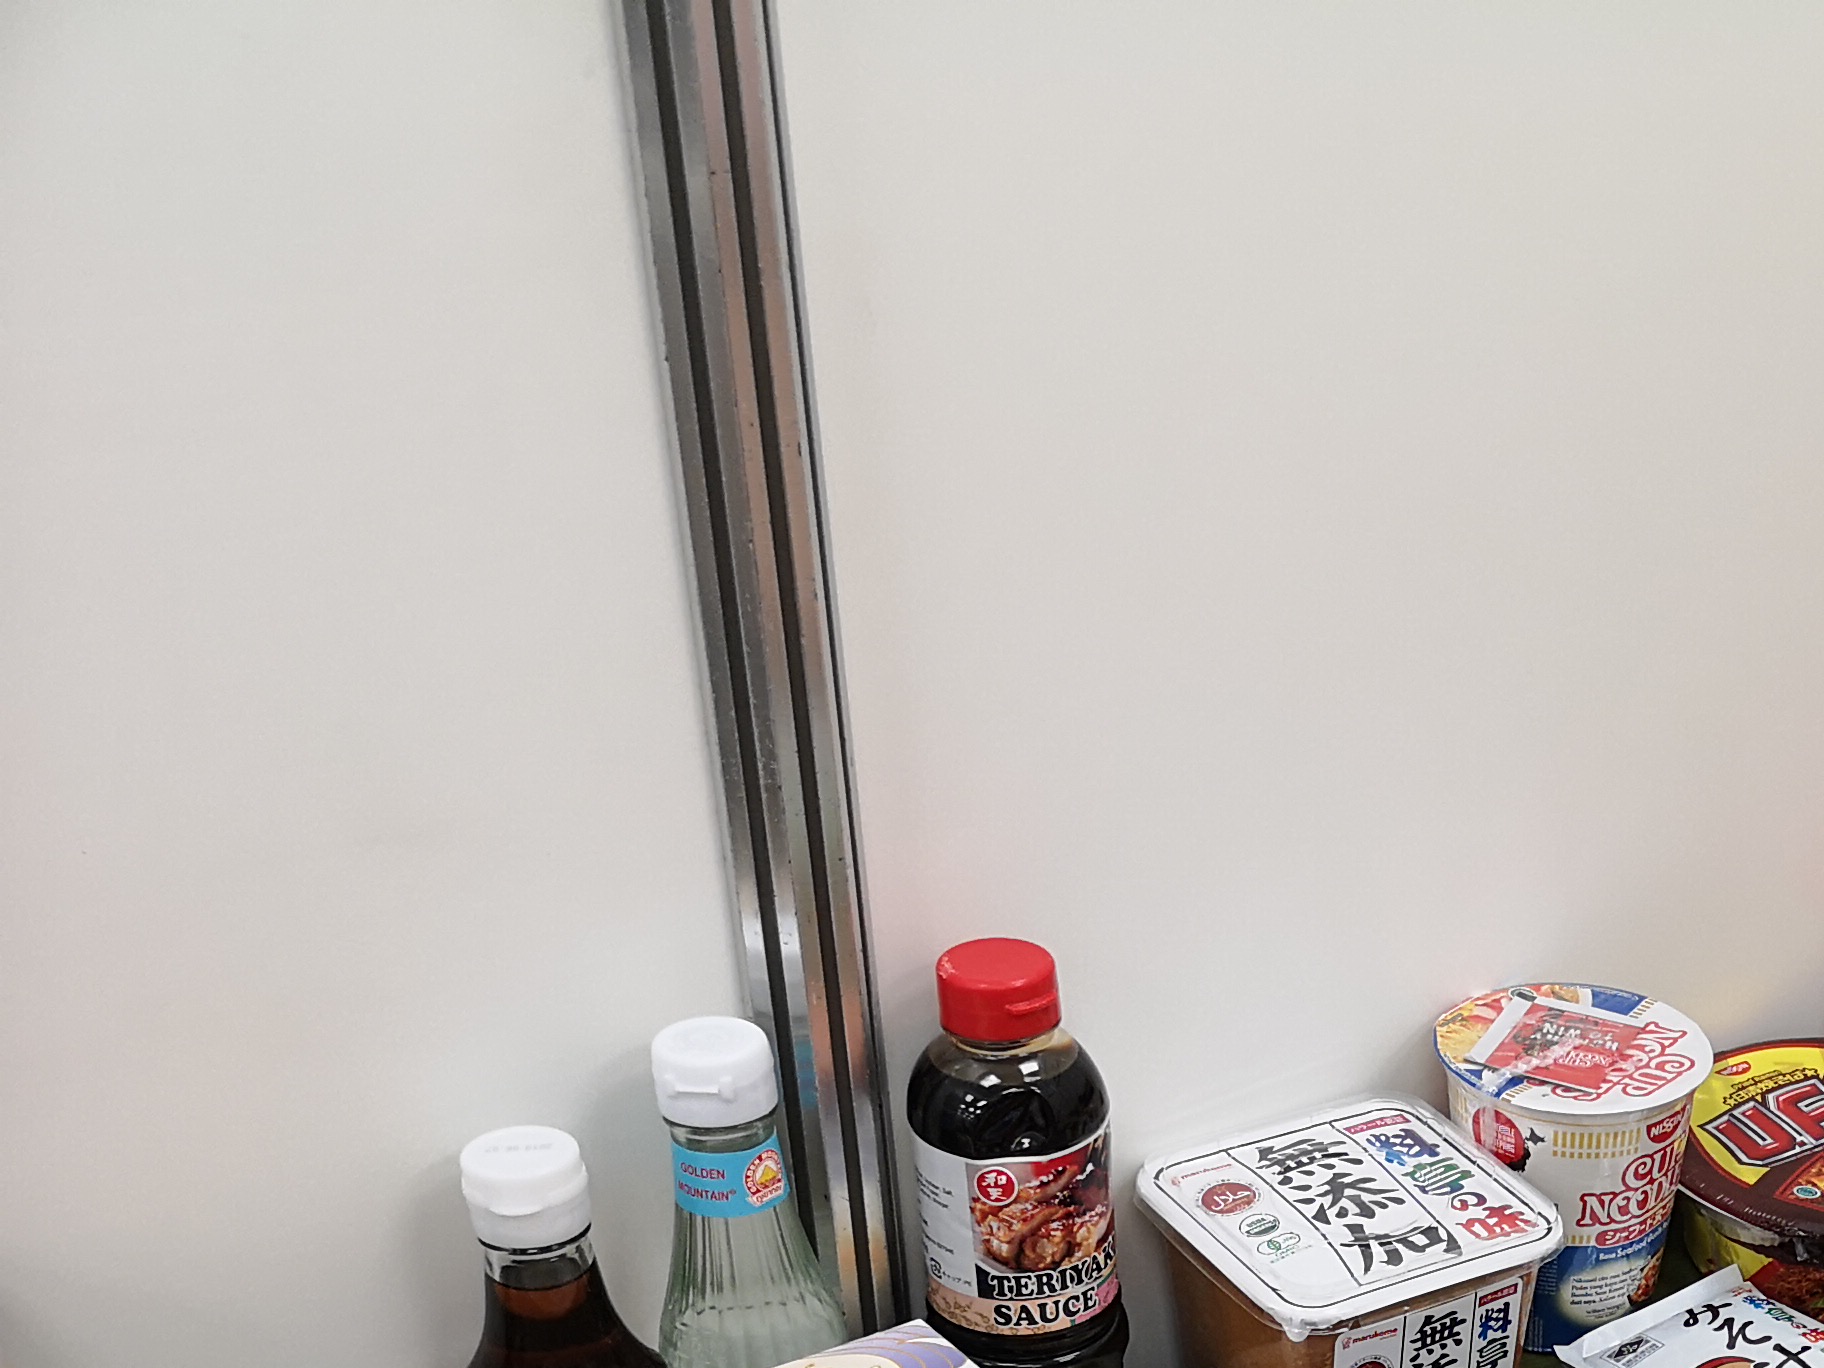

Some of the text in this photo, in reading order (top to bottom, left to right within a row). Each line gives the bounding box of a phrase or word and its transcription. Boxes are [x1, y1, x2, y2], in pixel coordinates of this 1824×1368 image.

[679, 1160, 726, 1182] GOLDEN
[1254, 1136, 1463, 1277] 無添加
[1365, 1127, 1540, 1242] 料亭の味
[993, 1289, 1100, 1329] SAUCE
